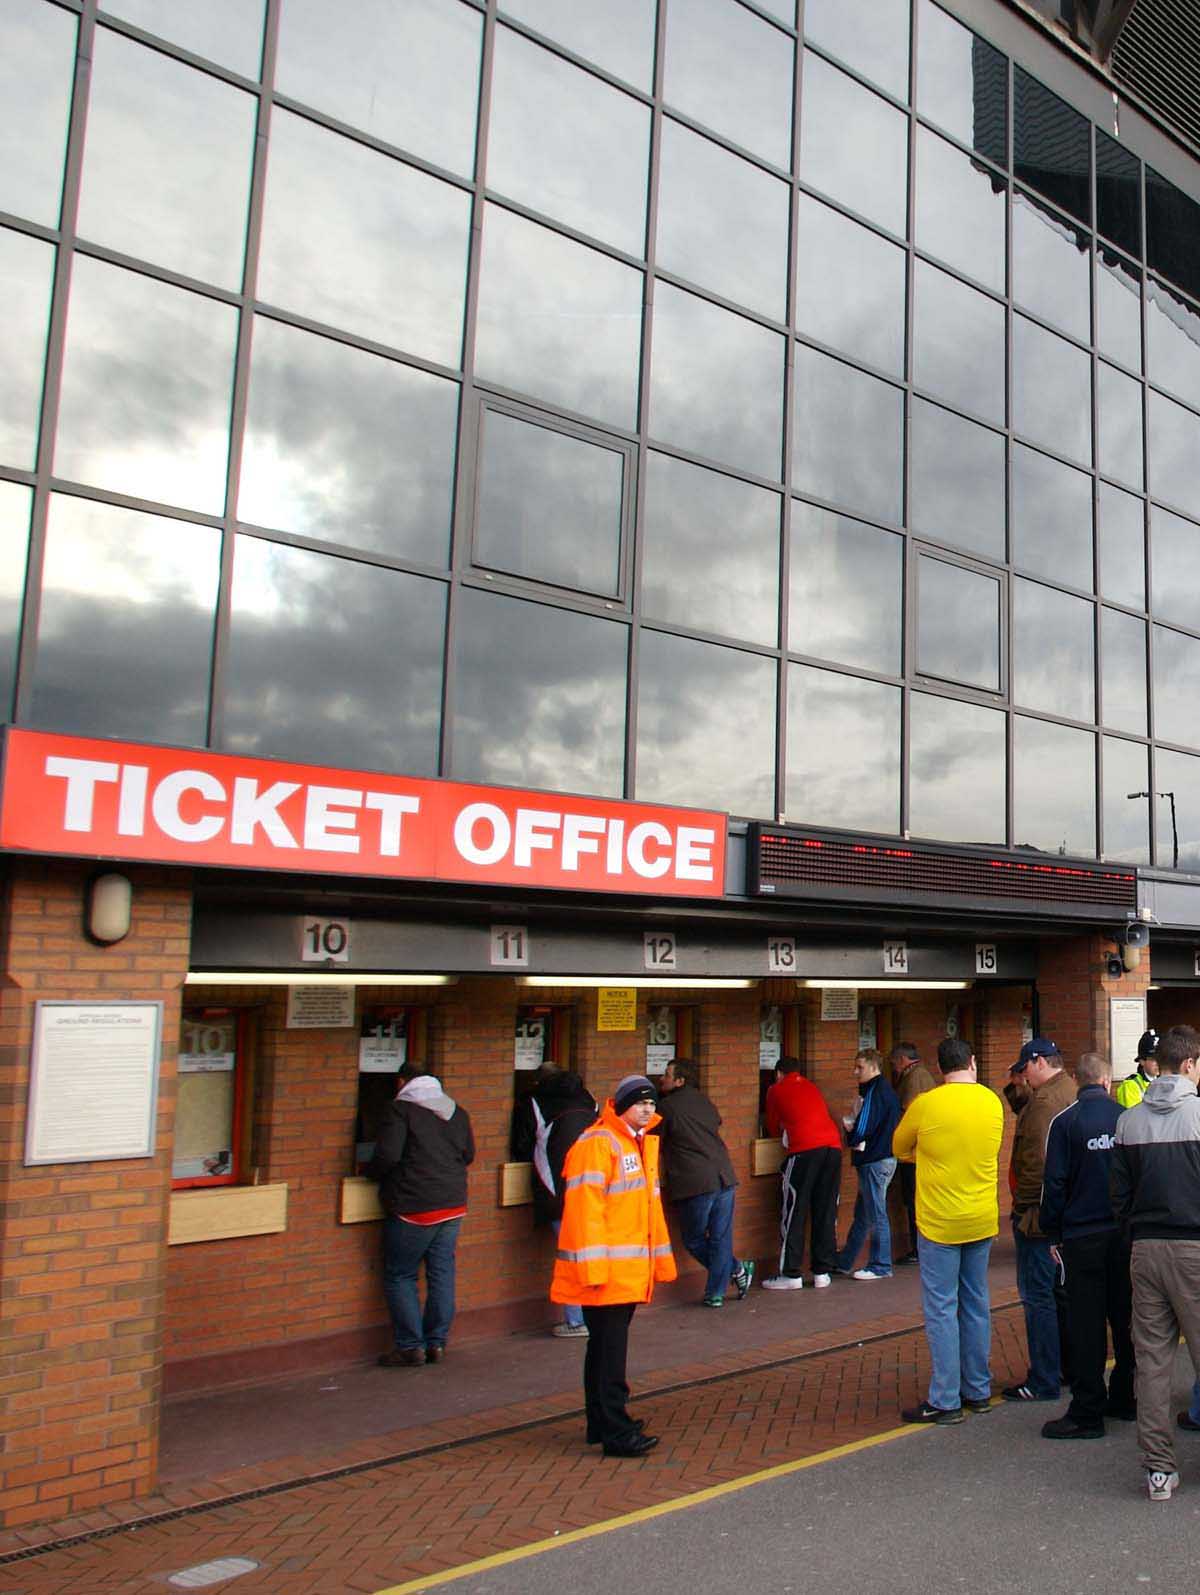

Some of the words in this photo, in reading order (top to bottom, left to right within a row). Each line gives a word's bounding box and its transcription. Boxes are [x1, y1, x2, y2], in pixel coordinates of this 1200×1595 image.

[45, 755, 420, 858] TICKET
[454, 802, 715, 881] OFFICE
[306, 923, 347, 954] 10
[497, 930, 523, 959] 11
[648, 938, 674, 963] 12
[770, 942, 794, 966] 13
[886, 946, 906, 968] 14
[978, 948, 995, 969] 15
[185, 1026, 227, 1055] 10
[648, 1022, 670, 1043] 13
